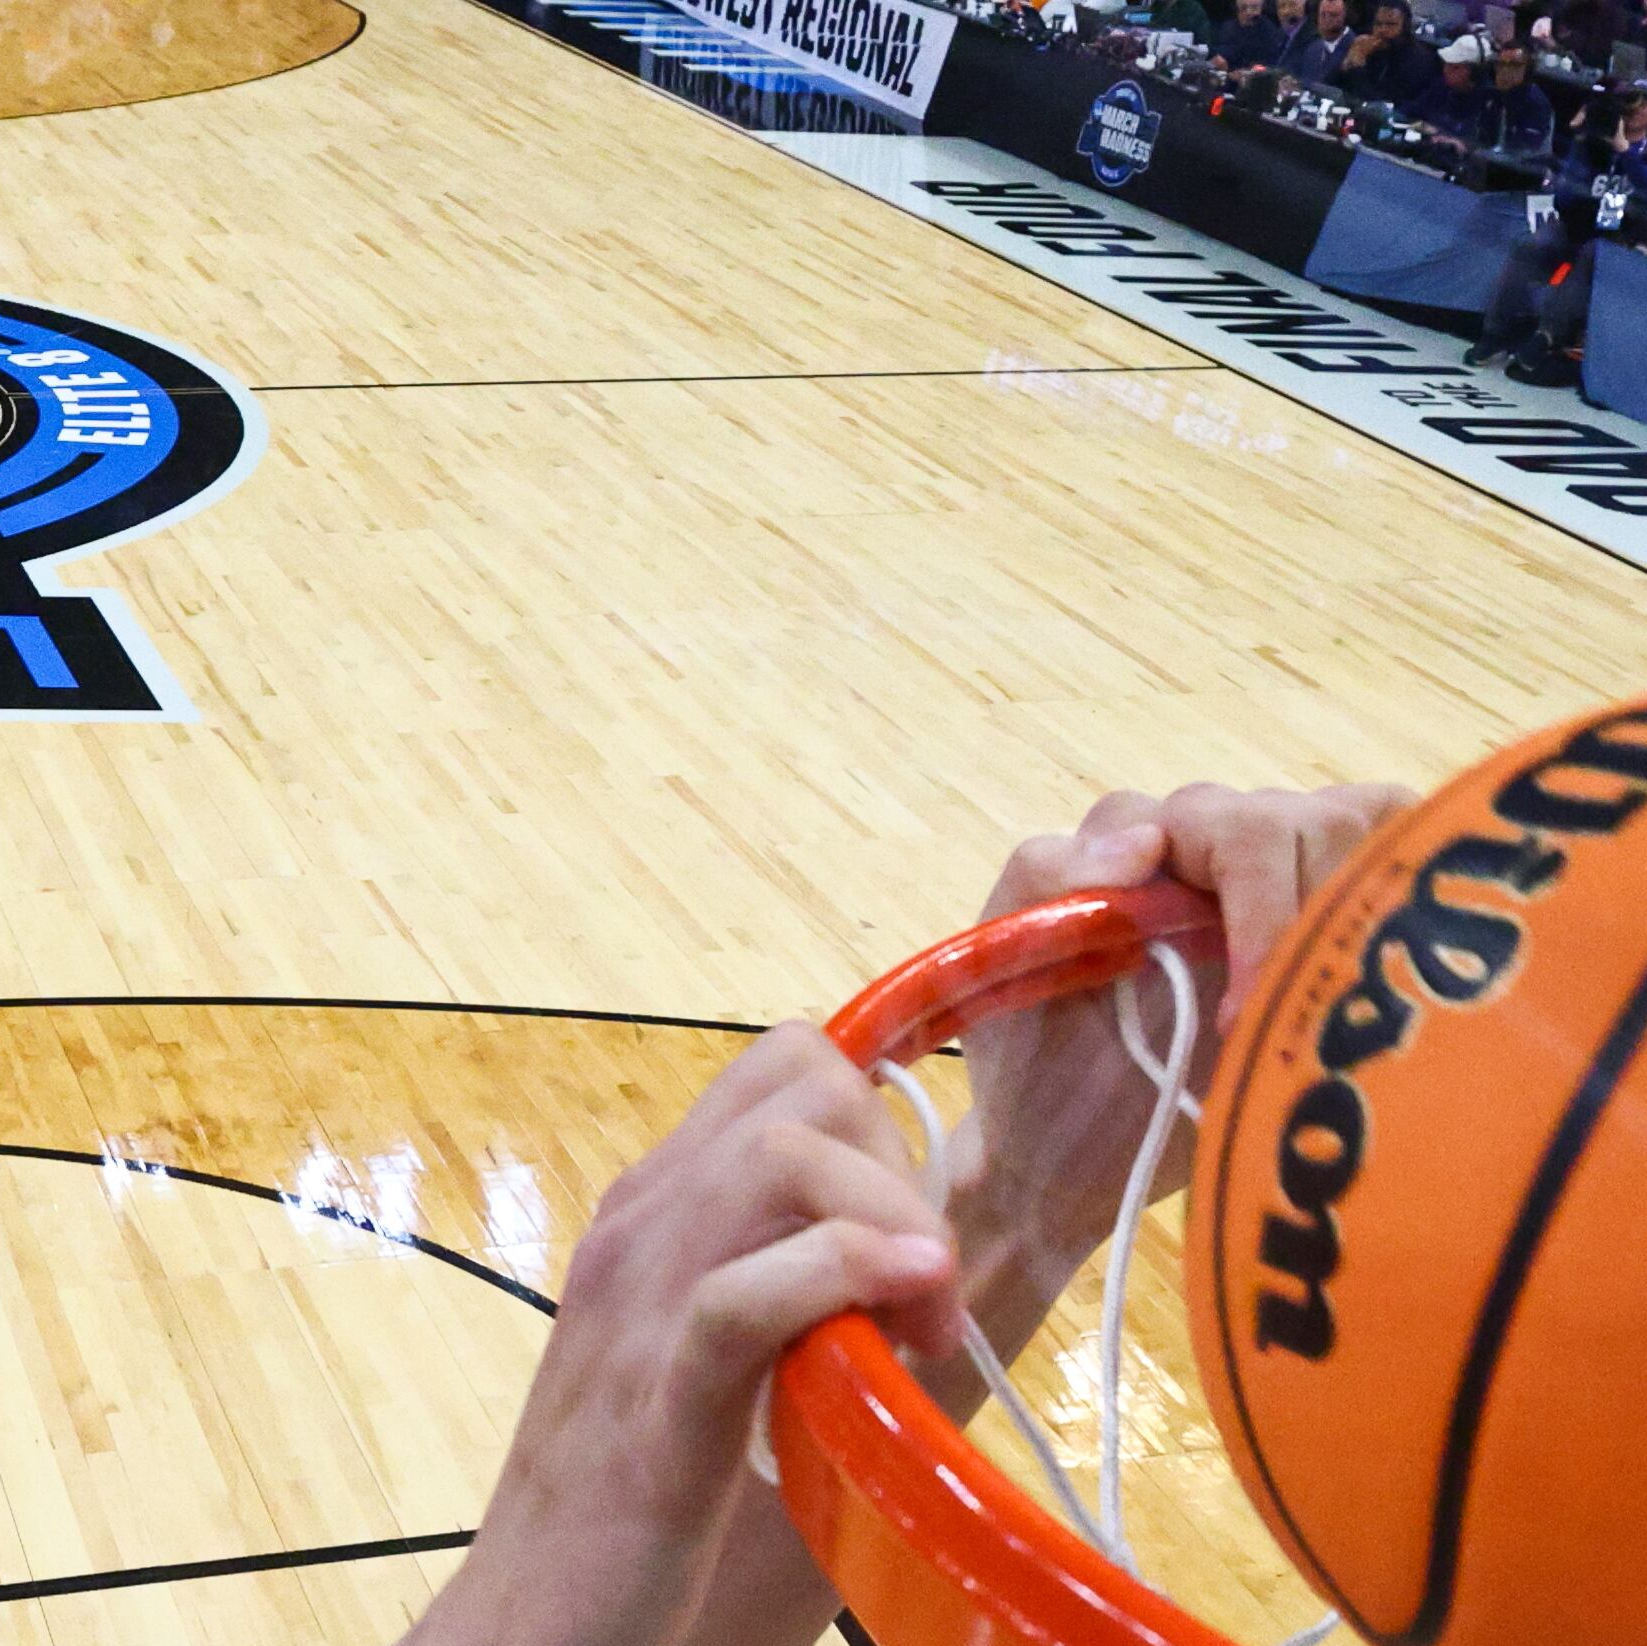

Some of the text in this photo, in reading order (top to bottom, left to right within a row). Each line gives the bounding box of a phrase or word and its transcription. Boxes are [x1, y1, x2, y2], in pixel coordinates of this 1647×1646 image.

[781, 0, 924, 97] REGIONAL
[910, 180, 1476, 376] FINAL FOUR
[7, 350, 151, 446] ELITE 8
[1422, 382, 1518, 409] THE
